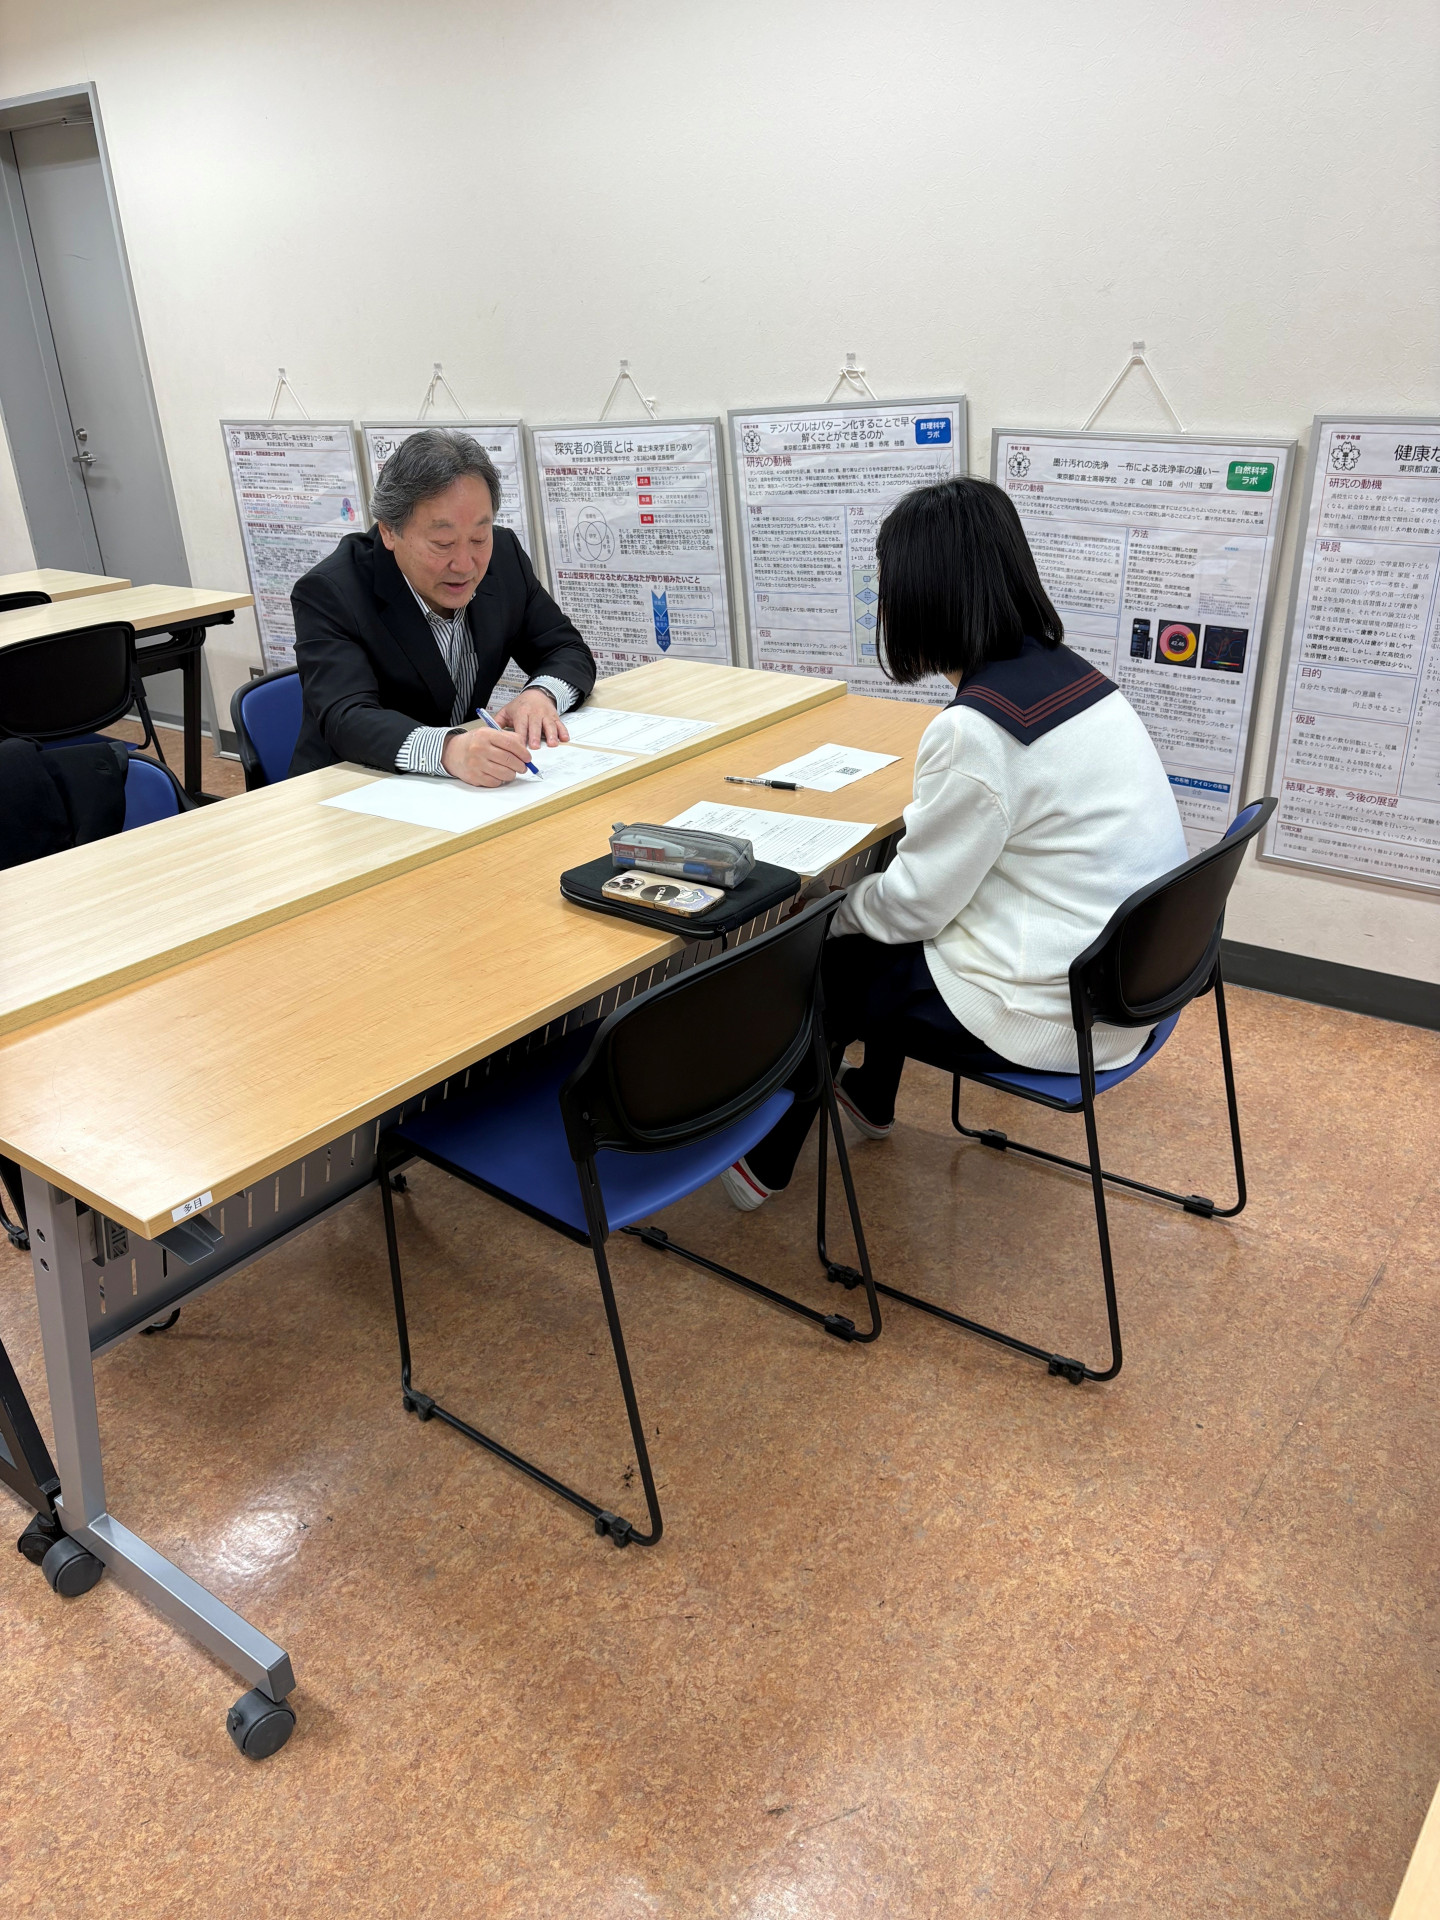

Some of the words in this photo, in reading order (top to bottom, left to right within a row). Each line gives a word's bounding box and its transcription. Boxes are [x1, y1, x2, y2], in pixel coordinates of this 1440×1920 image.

[769, 416, 918, 434] テンパズルはパターン化することで早く
[919, 421, 946, 431] 数理科学
[801, 430, 885, 442] 解くことができるのか
[926, 430, 941, 439] ラボ
[554, 440, 634, 455] 探究者の資質とは
[746, 455, 792, 468] 研究の動機
[1053, 457, 1109, 470] 墨汁汚れの洗浄
[1234, 466, 1268, 477] 自然科学
[1056, 473, 1117, 484] 東京都立富士高等学校
[1241, 476, 1259, 486] ラボ
[1328, 476, 1383, 491] 研究の動機
[1008, 482, 1044, 493] 研究の動機
[849, 507, 864, 516] 方法
[1132, 528, 1149, 539] 方法
[1319, 541, 1341, 553] 背景
[761, 662, 834, 675] 結果と考察、今後の展望
[1301, 667, 1322, 679] 目的
[1299, 682, 1383, 700] 自分たちで虫歯への意識を
[1352, 701, 1403, 714] 向上させること
[1295, 713, 1316, 726] 仮説
[1193, 779, 1229, 792] ナイロンの布地
[1285, 780, 1399, 809] 結果と考察、今後の展望
